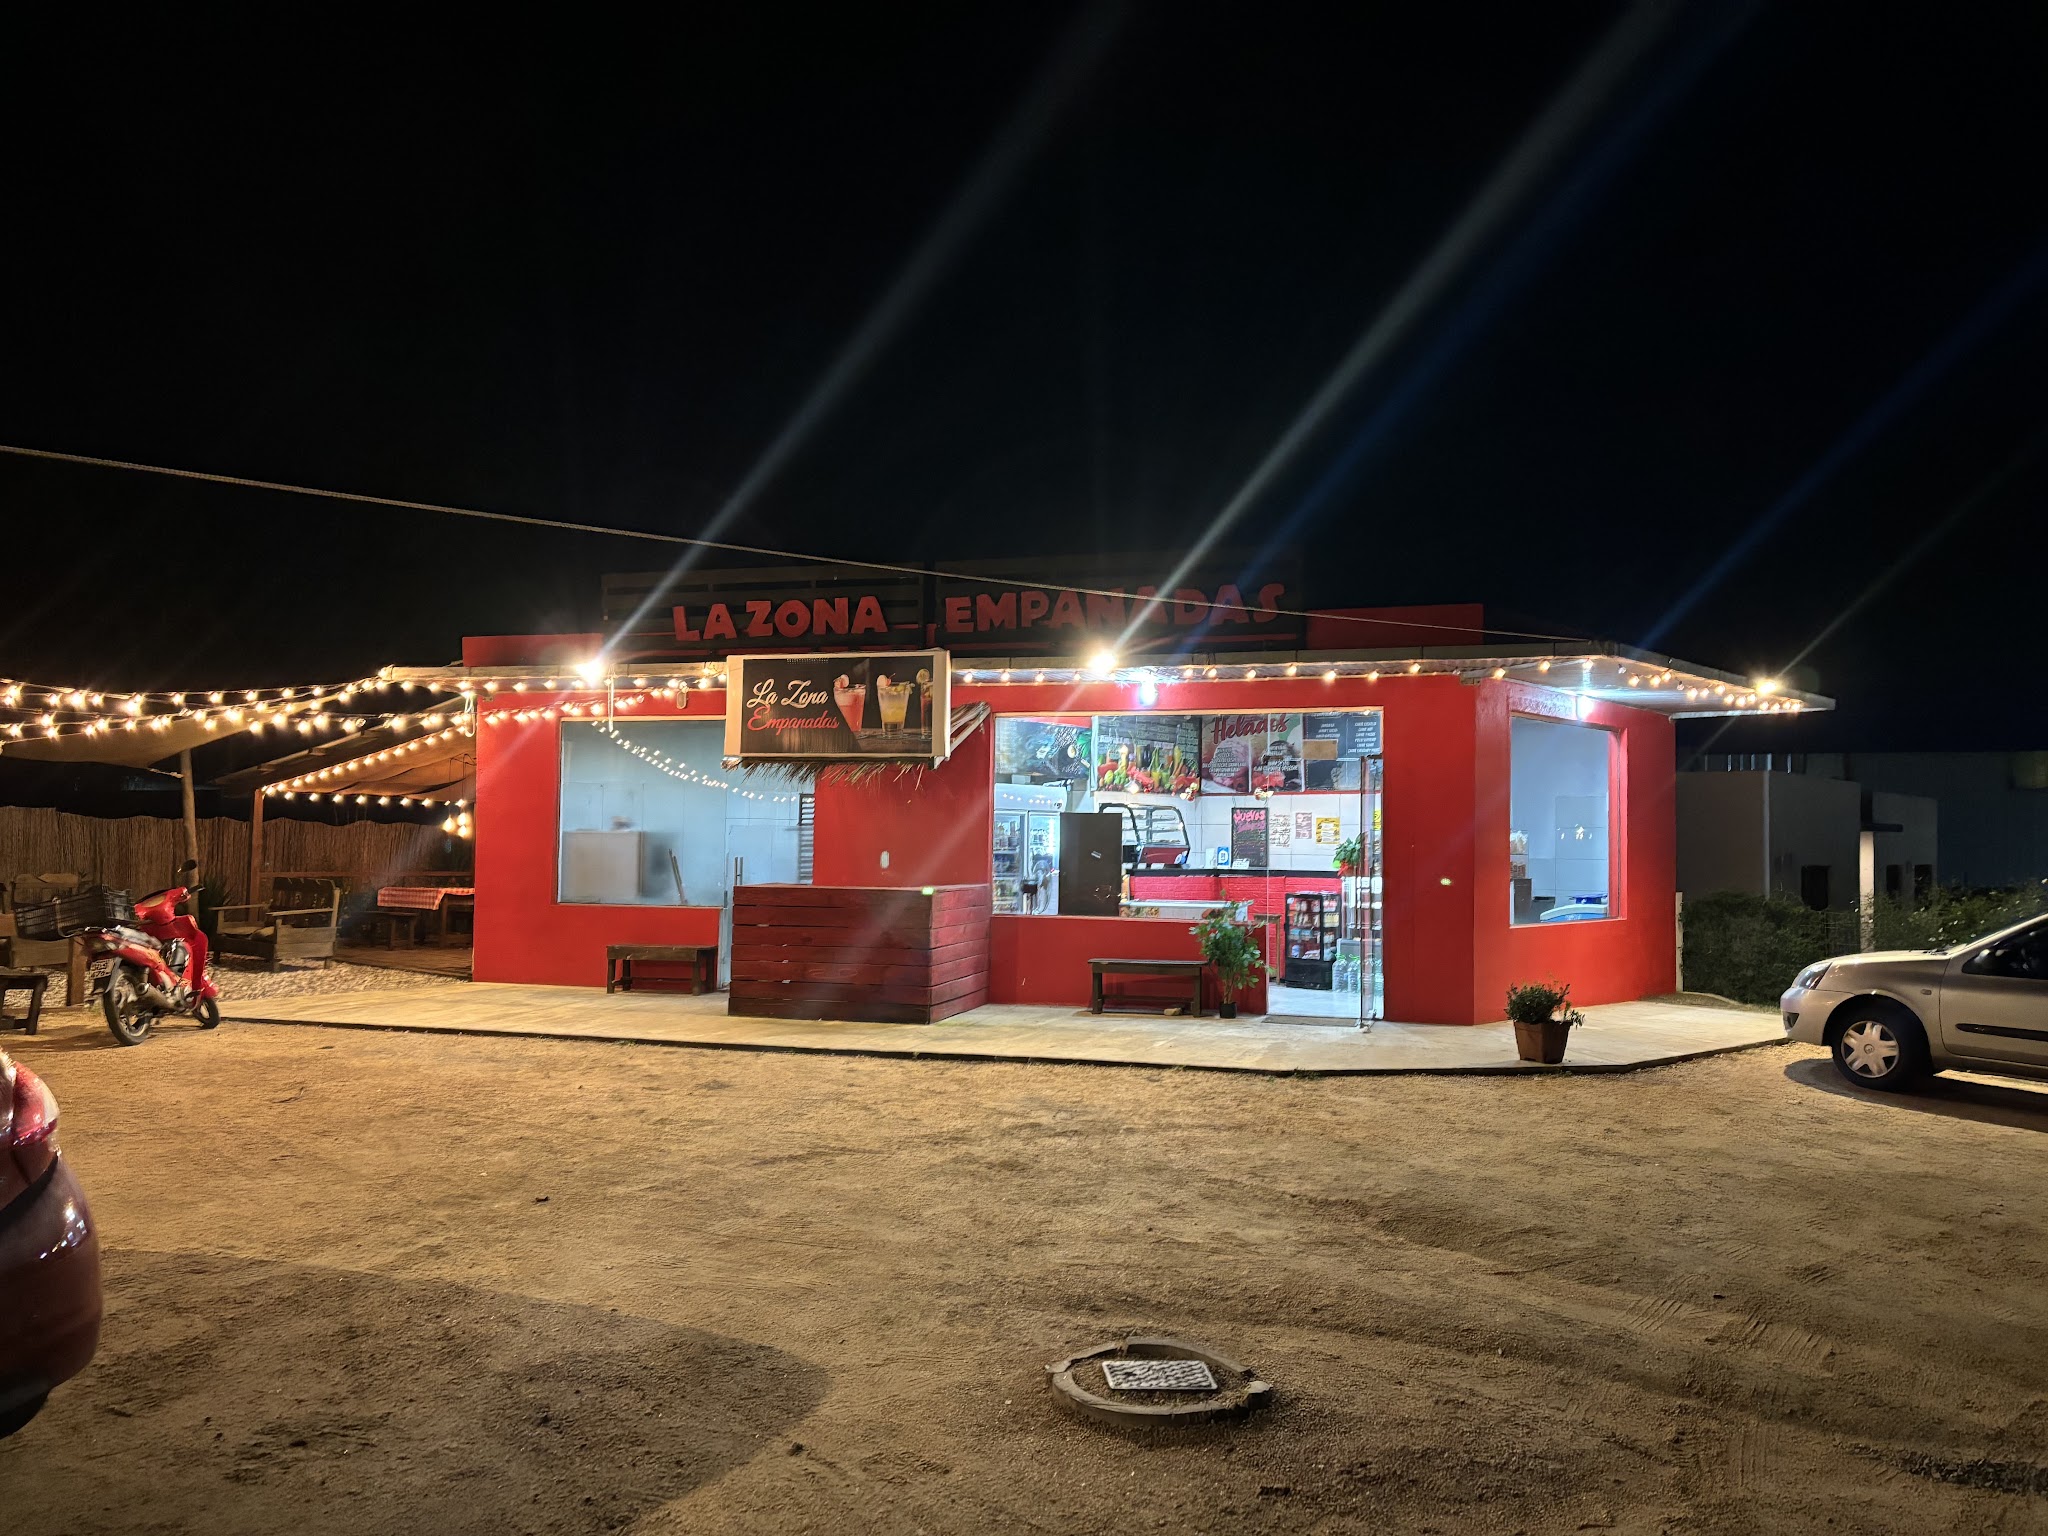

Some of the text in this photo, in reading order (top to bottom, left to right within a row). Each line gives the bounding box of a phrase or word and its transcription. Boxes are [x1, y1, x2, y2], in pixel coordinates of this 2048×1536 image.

[672, 583, 1285, 641] LA ZONA EMPANADAS
[746, 678, 829, 708] La Zona
[747, 705, 840, 736] Empanadas
[1211, 713, 1290, 744] Helados
